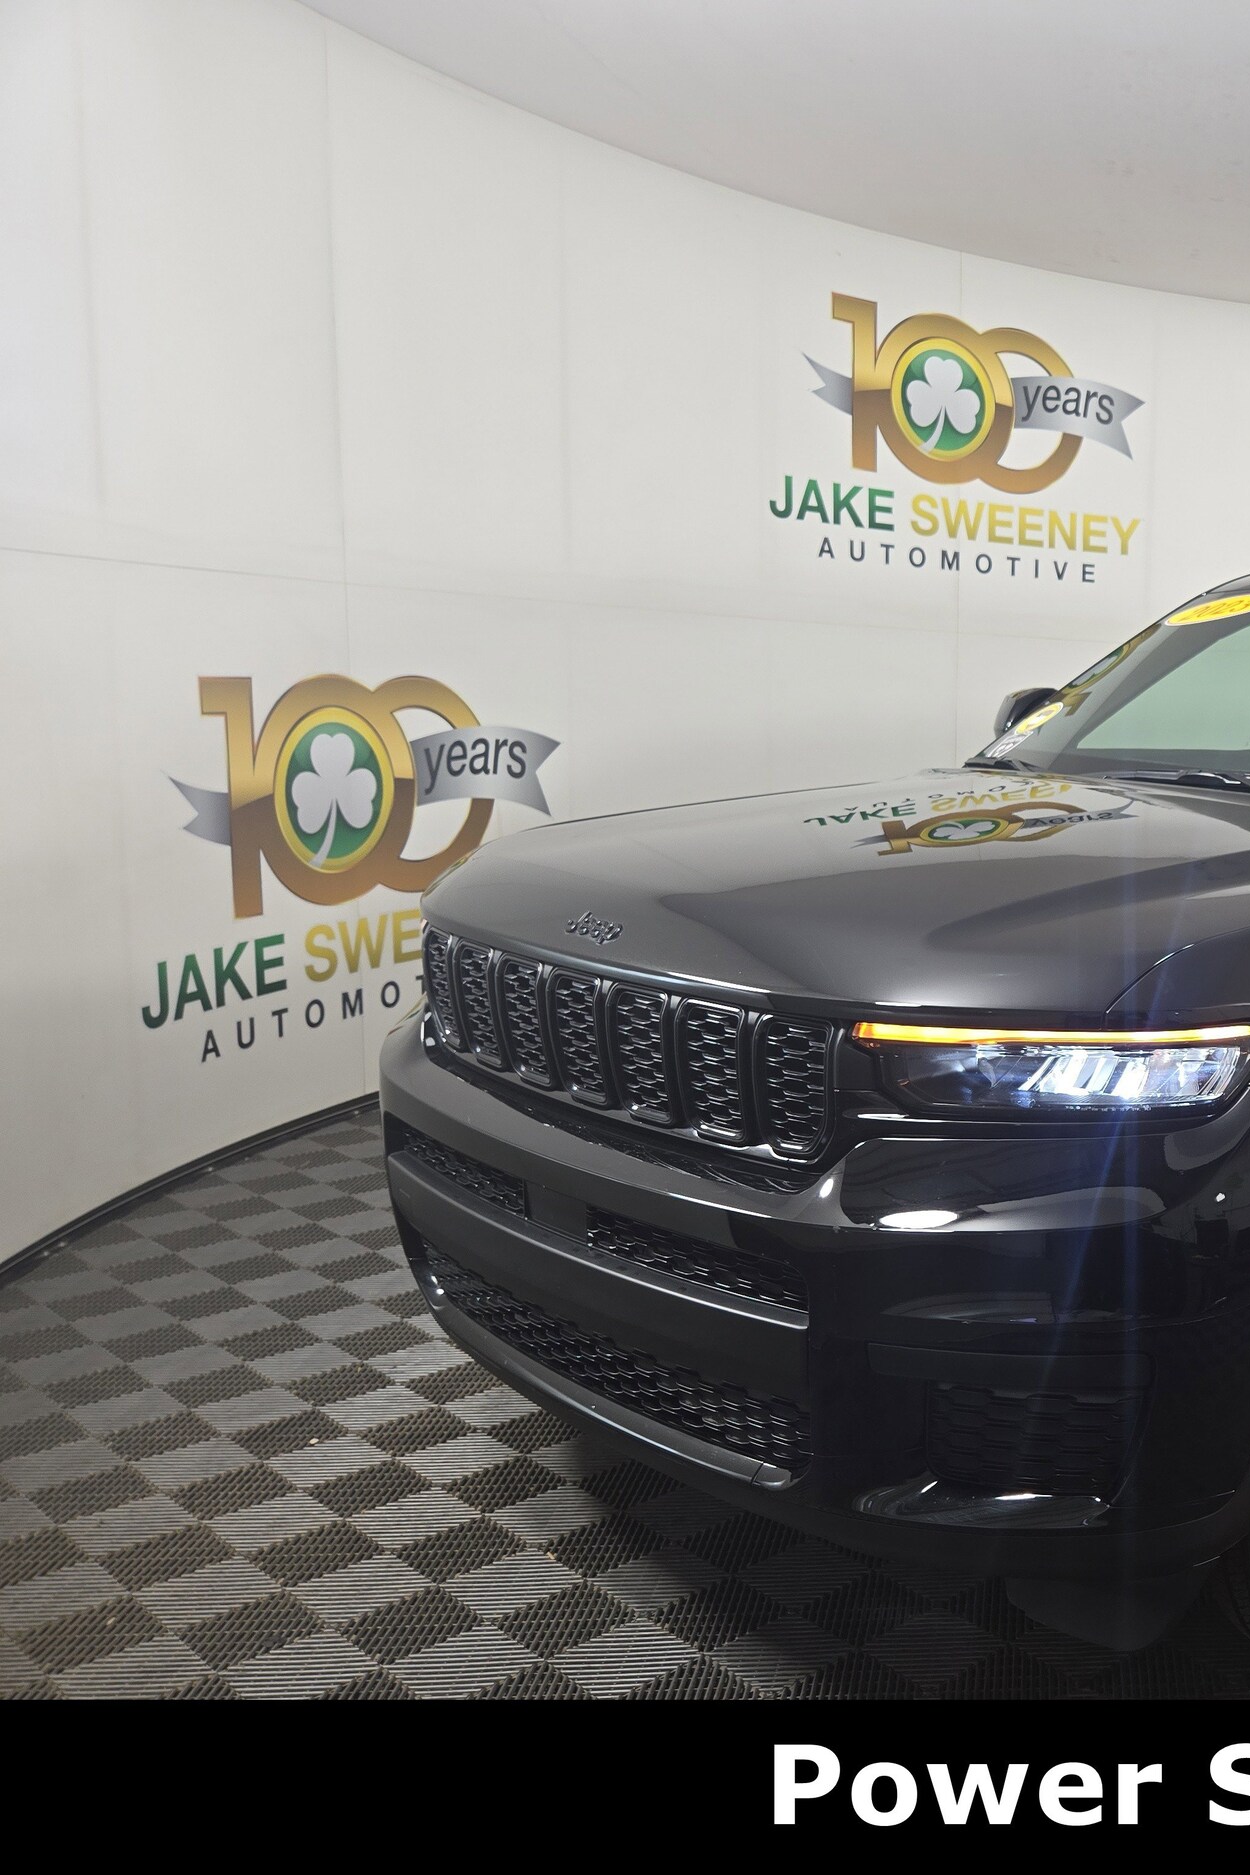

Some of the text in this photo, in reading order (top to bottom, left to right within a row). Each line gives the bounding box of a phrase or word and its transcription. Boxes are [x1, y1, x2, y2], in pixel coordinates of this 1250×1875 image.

[831, 292, 1114, 494] 100 years
[769, 475, 1141, 555] JAKE SWEENEY
[818, 537, 1095, 583] AUTOMOTIVE
[197, 674, 527, 919] 100 years
[565, 911, 623, 945] Jeep
[141, 934, 287, 1030] JAKE
